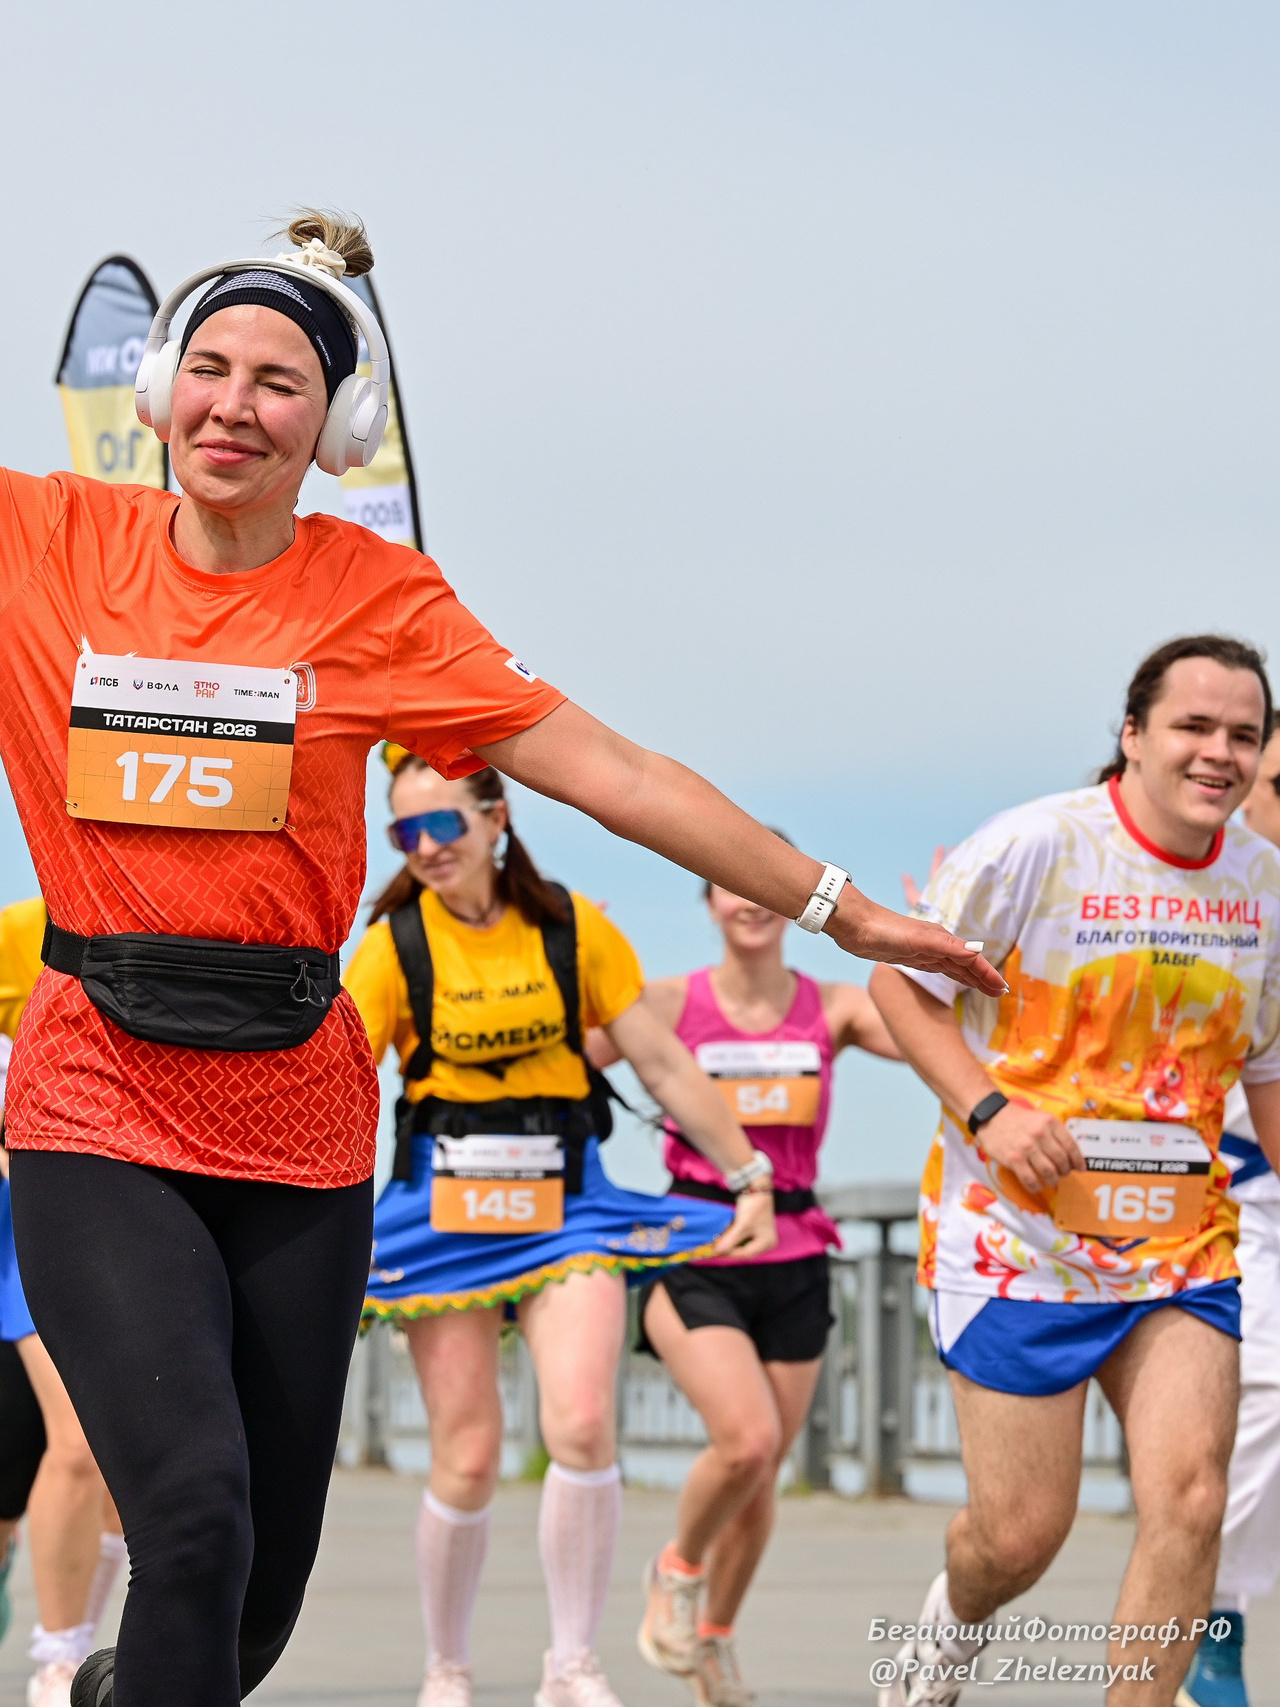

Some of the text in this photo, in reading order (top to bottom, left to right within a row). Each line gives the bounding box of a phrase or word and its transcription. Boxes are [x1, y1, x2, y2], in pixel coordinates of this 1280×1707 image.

[99, 677, 119, 687] ПСБ
[147, 682, 180, 692] ВФЛА
[103, 713, 257, 737] ТАТАРСТАН 2026
[115, 751, 233, 808] 175
[1081, 895, 1262, 930] БЕЗ ГРАНИЦ
[1075, 929, 1260, 948] БЛАГОТВОРИТЕЛЬНЫЙ
[736, 1085, 790, 1115] 54
[462, 1188, 536, 1222] 145
[1093, 1184, 1177, 1223] 165
